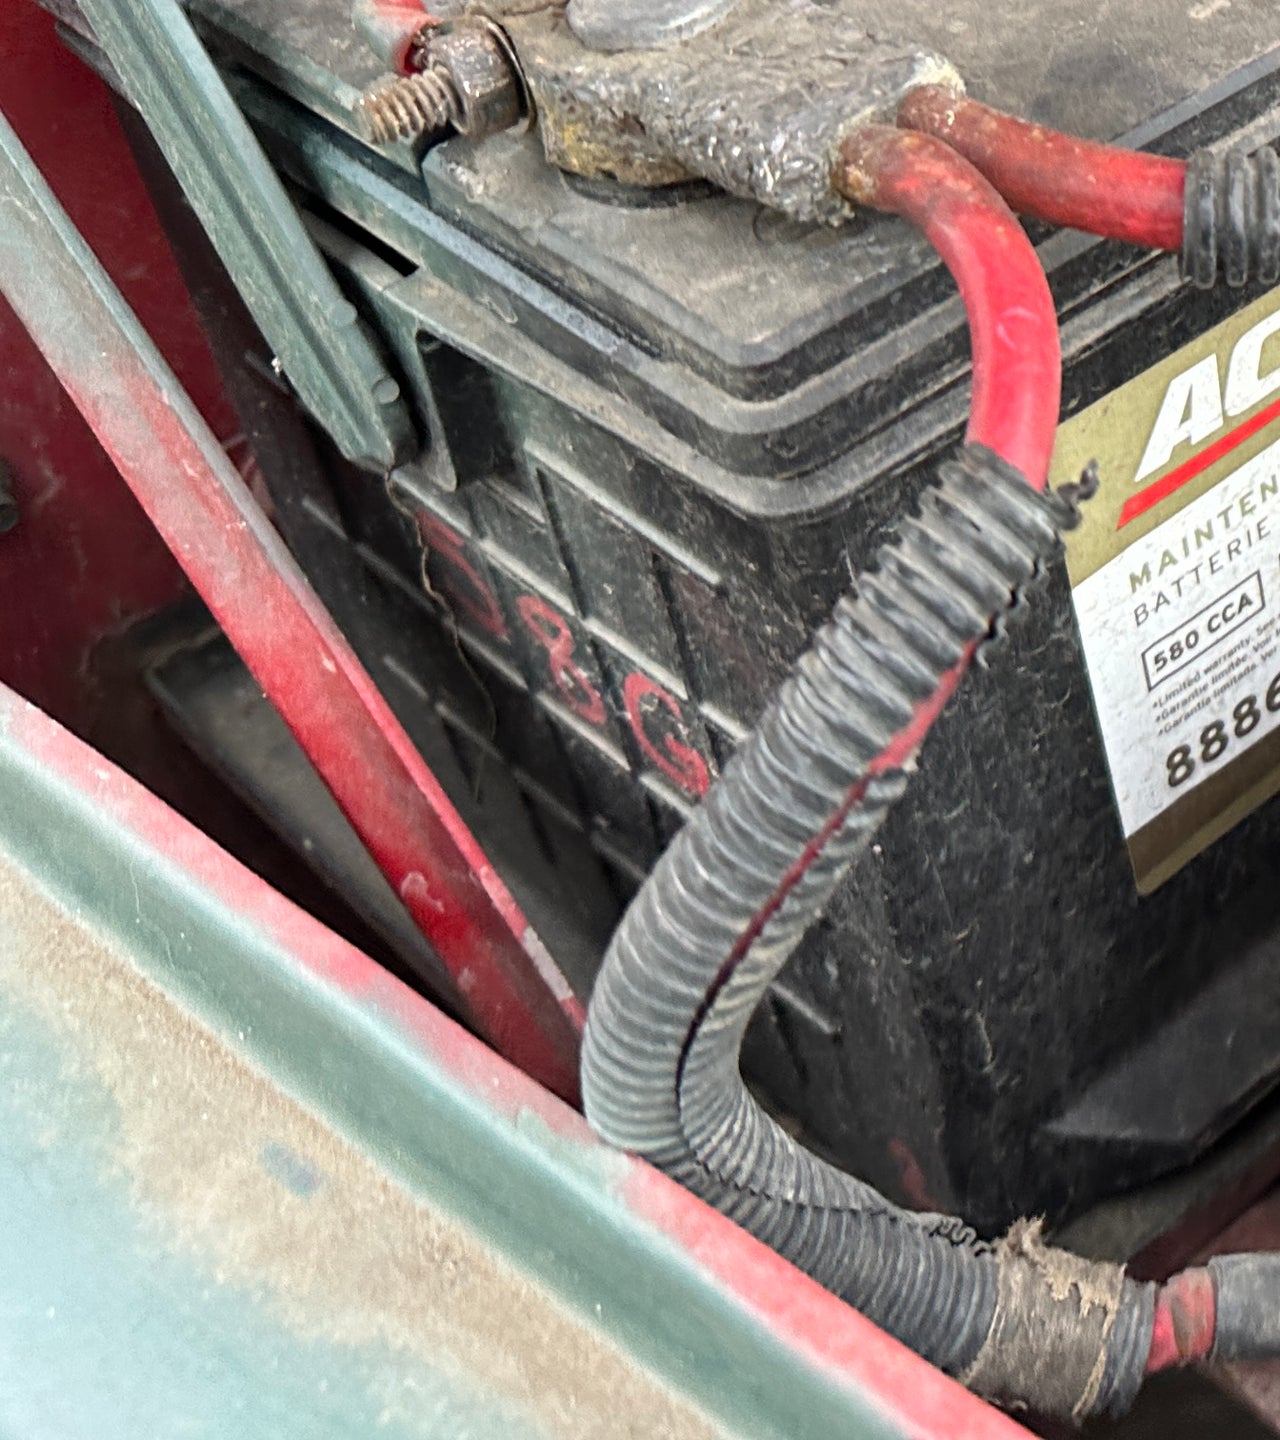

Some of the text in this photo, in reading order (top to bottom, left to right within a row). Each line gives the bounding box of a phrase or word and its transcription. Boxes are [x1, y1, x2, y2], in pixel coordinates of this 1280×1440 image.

[1134, 517, 1271, 627] BATTERIE
[1154, 593, 1253, 672] 580 CCA
